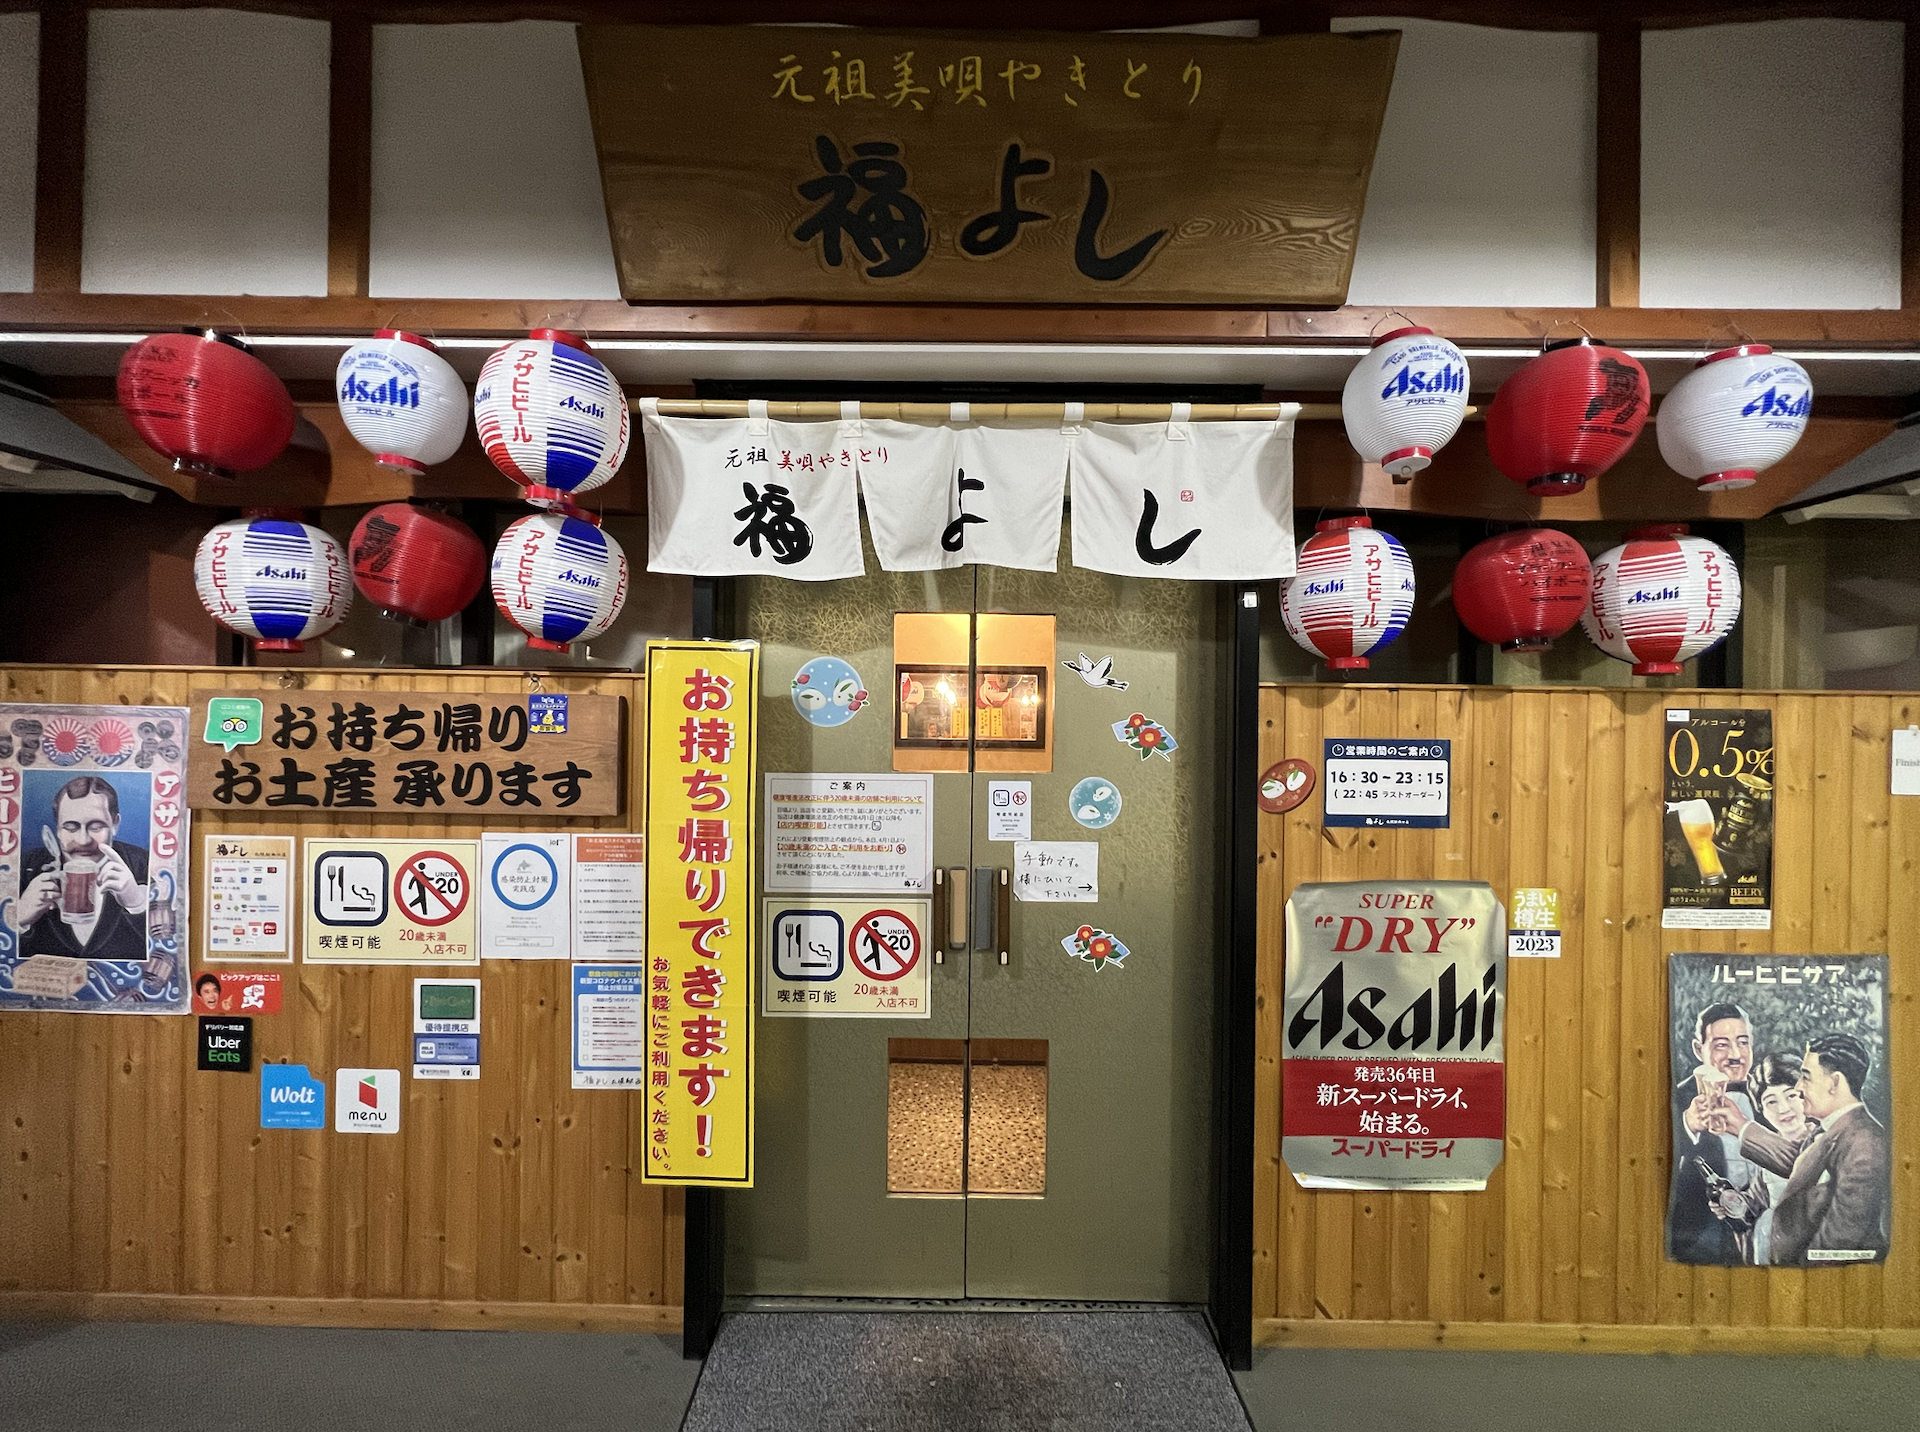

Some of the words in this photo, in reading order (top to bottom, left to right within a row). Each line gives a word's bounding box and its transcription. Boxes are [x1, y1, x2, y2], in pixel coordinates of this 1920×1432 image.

[771, 53, 1203, 110] 元祖美唄やきとり
[794, 135, 1169, 282] 福よし
[341, 371, 420, 410] Asahi
[1381, 362, 1465, 400] Asahi
[511, 349, 538, 443] アサヒビール
[559, 395, 606, 419] Asahi
[724, 446, 769, 469] 元祖
[776, 445, 889, 472] 美唄やきとり
[211, 531, 238, 614] アサヒビール
[255, 564, 307, 581] Asahi
[316, 540, 342, 618] アサヒビール
[516, 529, 546, 610] アサヒビール
[558, 569, 601, 588] Asahi
[1303, 579, 1344, 596] Asahi
[1360, 544, 1382, 628] アサヒビール
[1627, 586, 1680, 605] Asahi
[1695, 550, 1723, 635] アサヒビール
[1592, 563, 1615, 641] アサヒビール
[271, 701, 528, 754] お持ち帰り
[1691, 718, 1746, 727] アルコール分
[1345, 745, 1429, 757] 営業時間のご案内
[1668, 728, 1774, 778] 0.5%
[212, 757, 377, 807] お土産
[392, 758, 593, 808] 承ります
[829, 781, 866, 791] ご案内
[154, 773, 181, 857] アサヒ
[1021, 850, 1079, 868] 手動です。
[435, 877, 459, 894] 20
[1018, 873, 1073, 886] 横にひいて
[1044, 889, 1077, 898] 下さい。
[1358, 892, 1436, 910] SUPER
[1730, 887, 1764, 897] BEERY
[678, 668, 735, 1158] お持ち帰りできます！
[1513, 907, 1556, 928] 樽生
[319, 935, 381, 949] 喫煙可能
[399, 929, 447, 941] 20歳未満
[888, 935, 911, 951] 20
[1515, 937, 1555, 952] 2023
[422, 944, 467, 955] 入店不可
[777, 989, 837, 1003] 喫煙可能
[853, 983, 899, 996] 20歳未満
[876, 998, 918, 1008] 入店不可
[1287, 960, 1497, 1051] Asahi
[208, 1035, 241, 1049] Uber
[208, 1049, 240, 1063] Eats
[651, 955, 671, 1171] お気軽にご利用ください。
[1353, 1066, 1436, 1084] 発売36年目
[270, 1086, 316, 1104] Wolt
[1316, 1082, 1469, 1110] 新スーパードライ、
[348, 1111, 387, 1121] menu
[1358, 1109, 1430, 1136] 始まる。
[1331, 1138, 1456, 1160] スーパードライ
